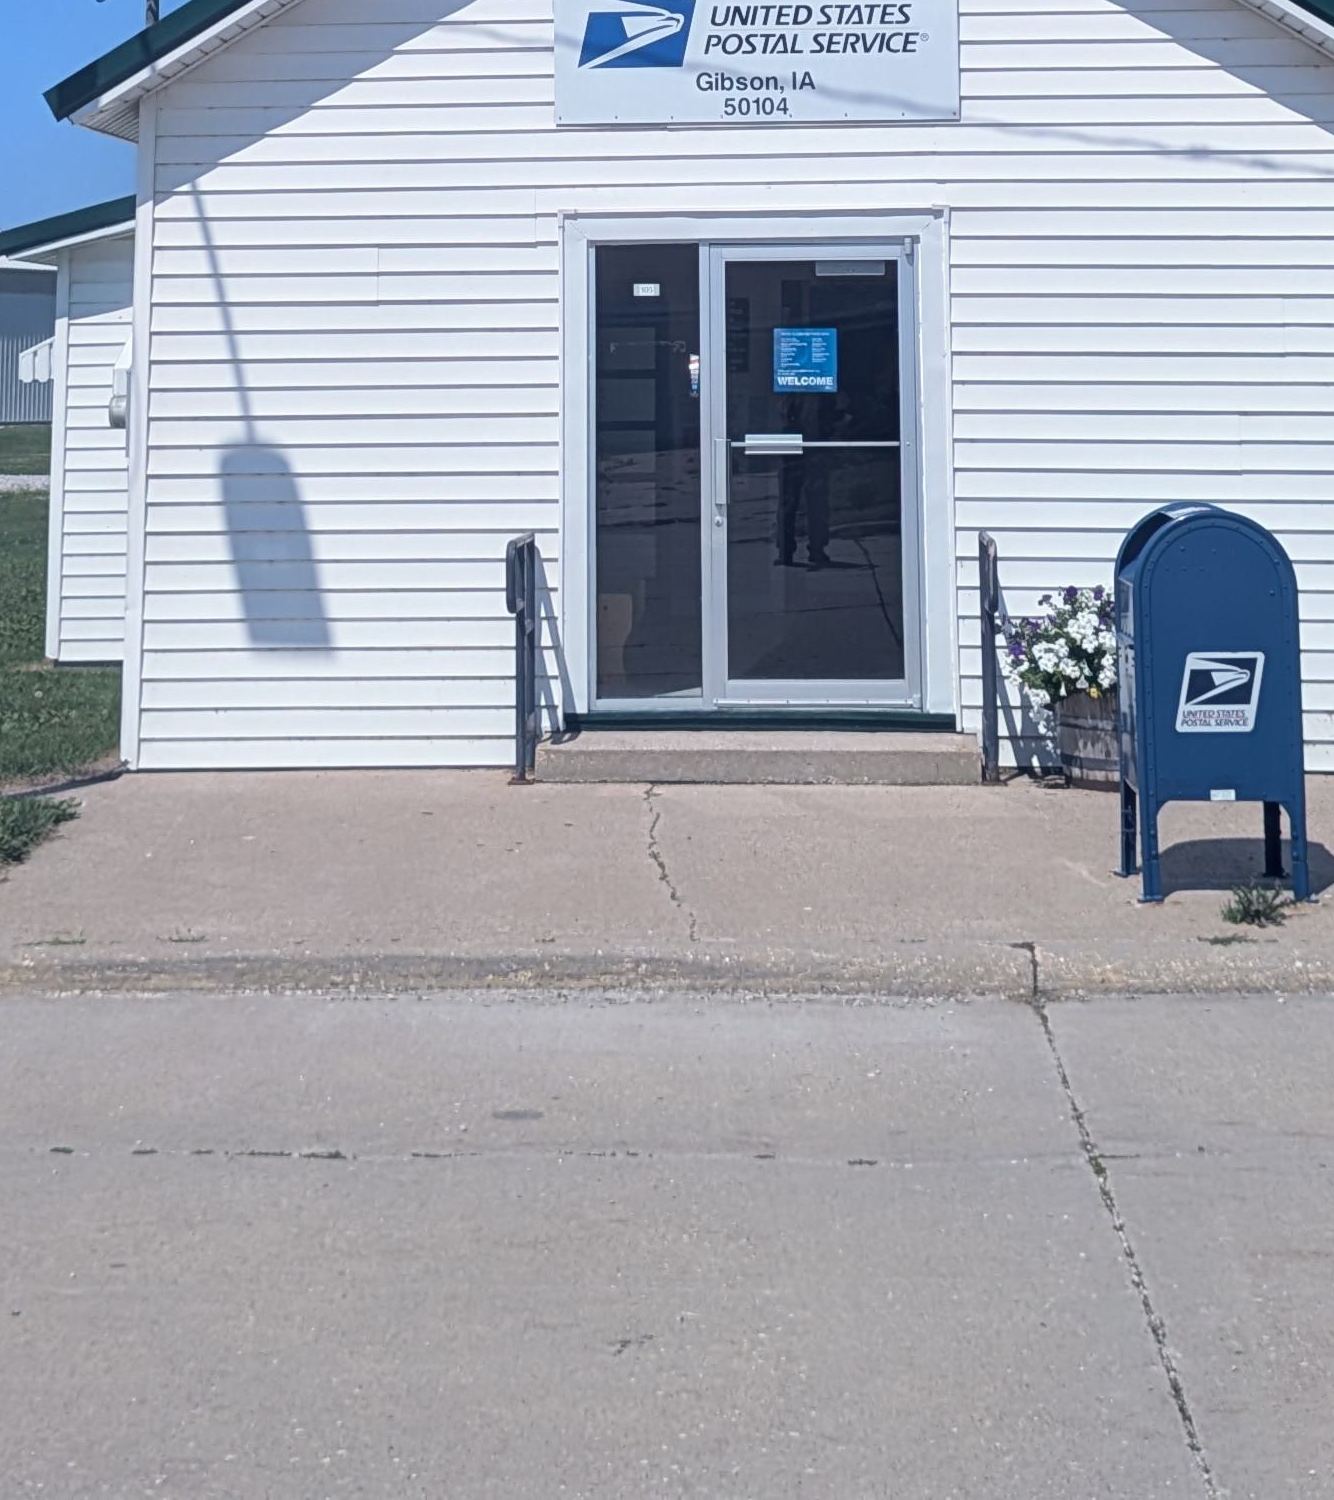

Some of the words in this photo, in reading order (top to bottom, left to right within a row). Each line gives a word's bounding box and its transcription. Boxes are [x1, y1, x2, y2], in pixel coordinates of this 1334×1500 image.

[710, 4, 813, 26] UNITED
[816, 3, 912, 26] STATES
[703, 33, 805, 55] POSTAL
[695, 71, 785, 94] Gibson,
[791, 70, 816, 91] IA
[723, 96, 789, 116] 50104
[777, 376, 834, 386] WELCOME
[1180, 719, 1212, 727] POSTAL
[1213, 718, 1249, 727] SERVICE
[1182, 709, 1216, 720] UNITED
[1216, 709, 1246, 719] STATES
